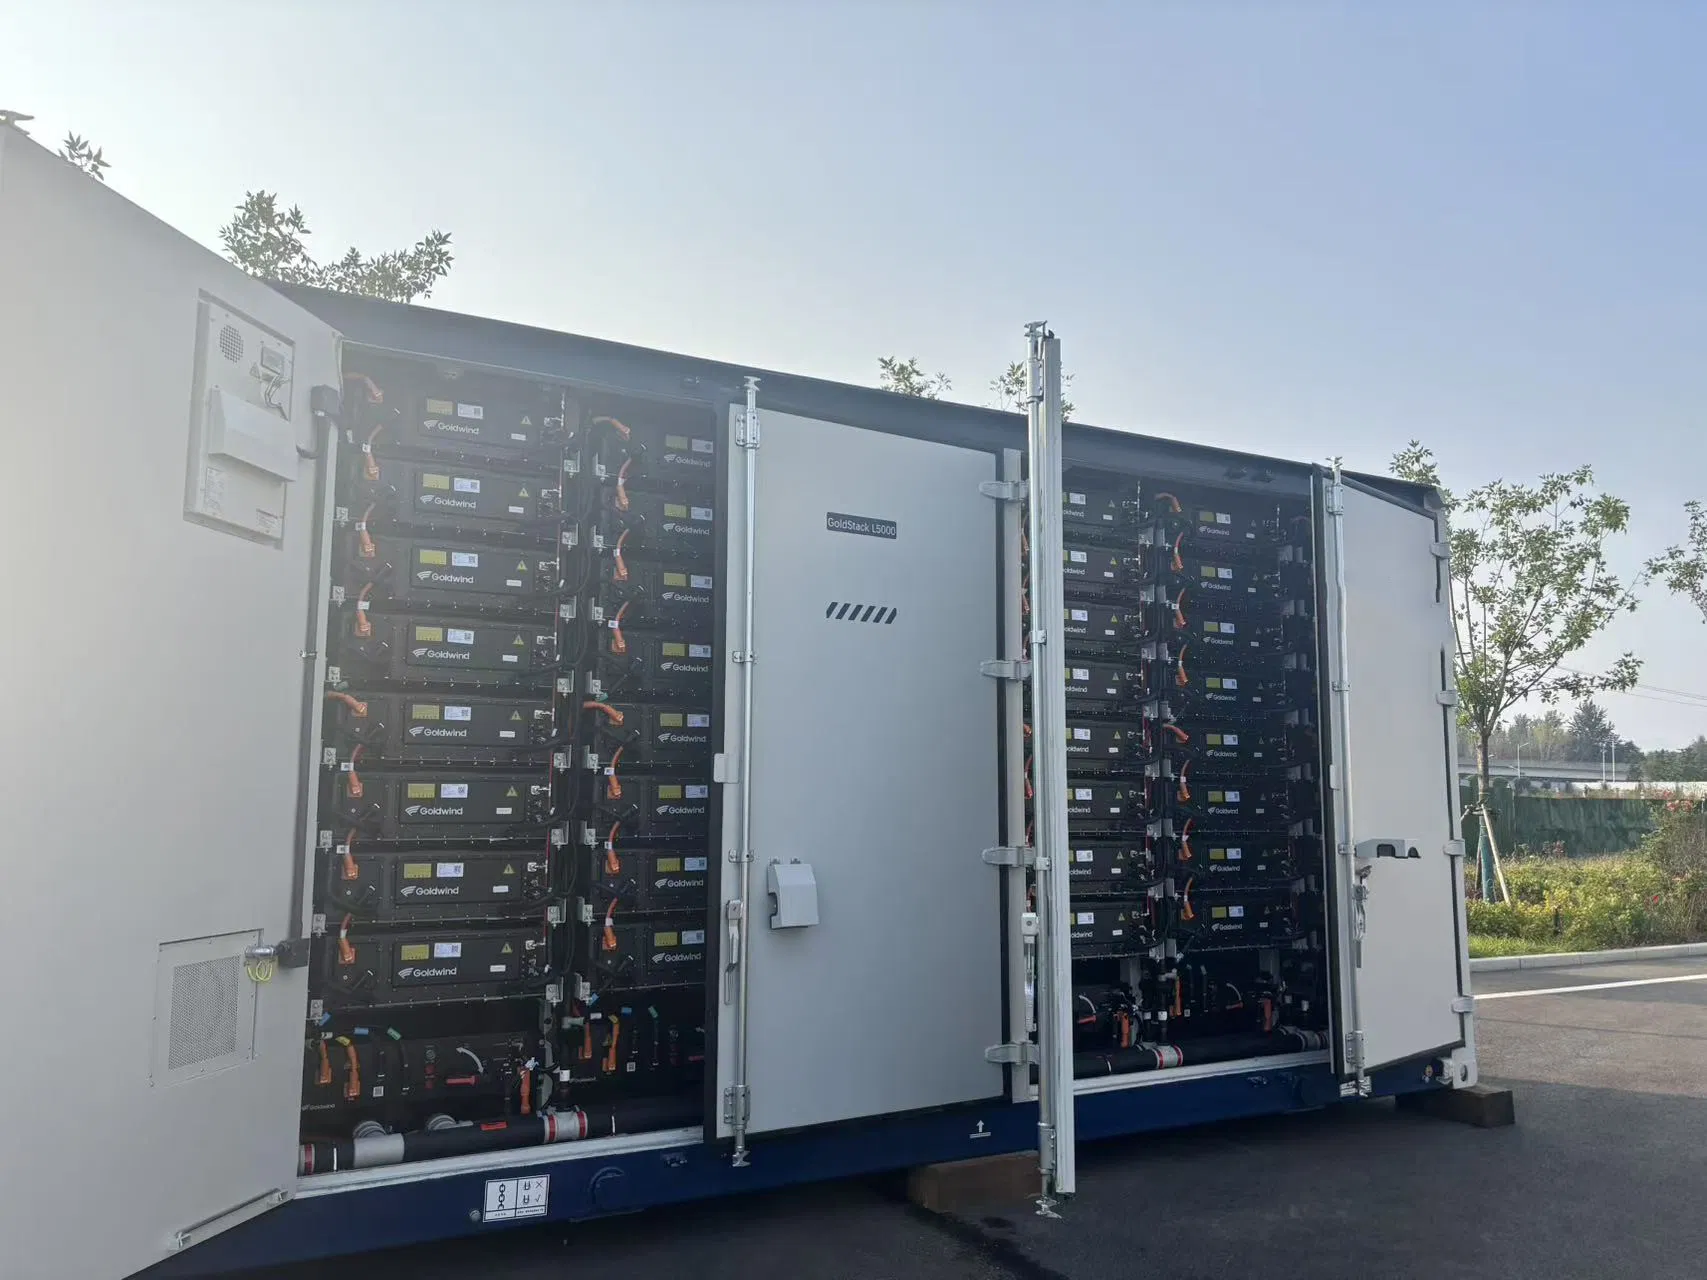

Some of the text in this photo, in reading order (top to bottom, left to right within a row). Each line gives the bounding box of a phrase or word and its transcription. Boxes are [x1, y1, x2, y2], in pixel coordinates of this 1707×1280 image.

[438, 422, 479, 434] Goldwind
[675, 455, 711, 467] Goldwind
[434, 496, 476, 509] Goldwind
[1063, 509, 1084, 518] oldwind
[675, 523, 710, 535] Goldwind
[828, 517, 896, 536] GoldStack L5000
[432, 572, 474, 584] Goldwind
[674, 592, 710, 603] Goldwind
[1064, 626, 1086, 634] oldwind
[428, 649, 470, 660] Goldwind
[673, 662, 708, 672] Goldwind
[424, 727, 467, 738] Goldwind
[671, 734, 706, 743] Goldwind
[1066, 745, 1089, 753] oldwind
[420, 806, 463, 816] Goldwind
[668, 805, 705, 815] Goldwind
[667, 878, 703, 888] Goldwind
[416, 885, 459, 896] Goldwind
[1071, 930, 1093, 938] oldwind
[664, 952, 701, 963] Goldwind
[413, 966, 457, 978] Goldwind
